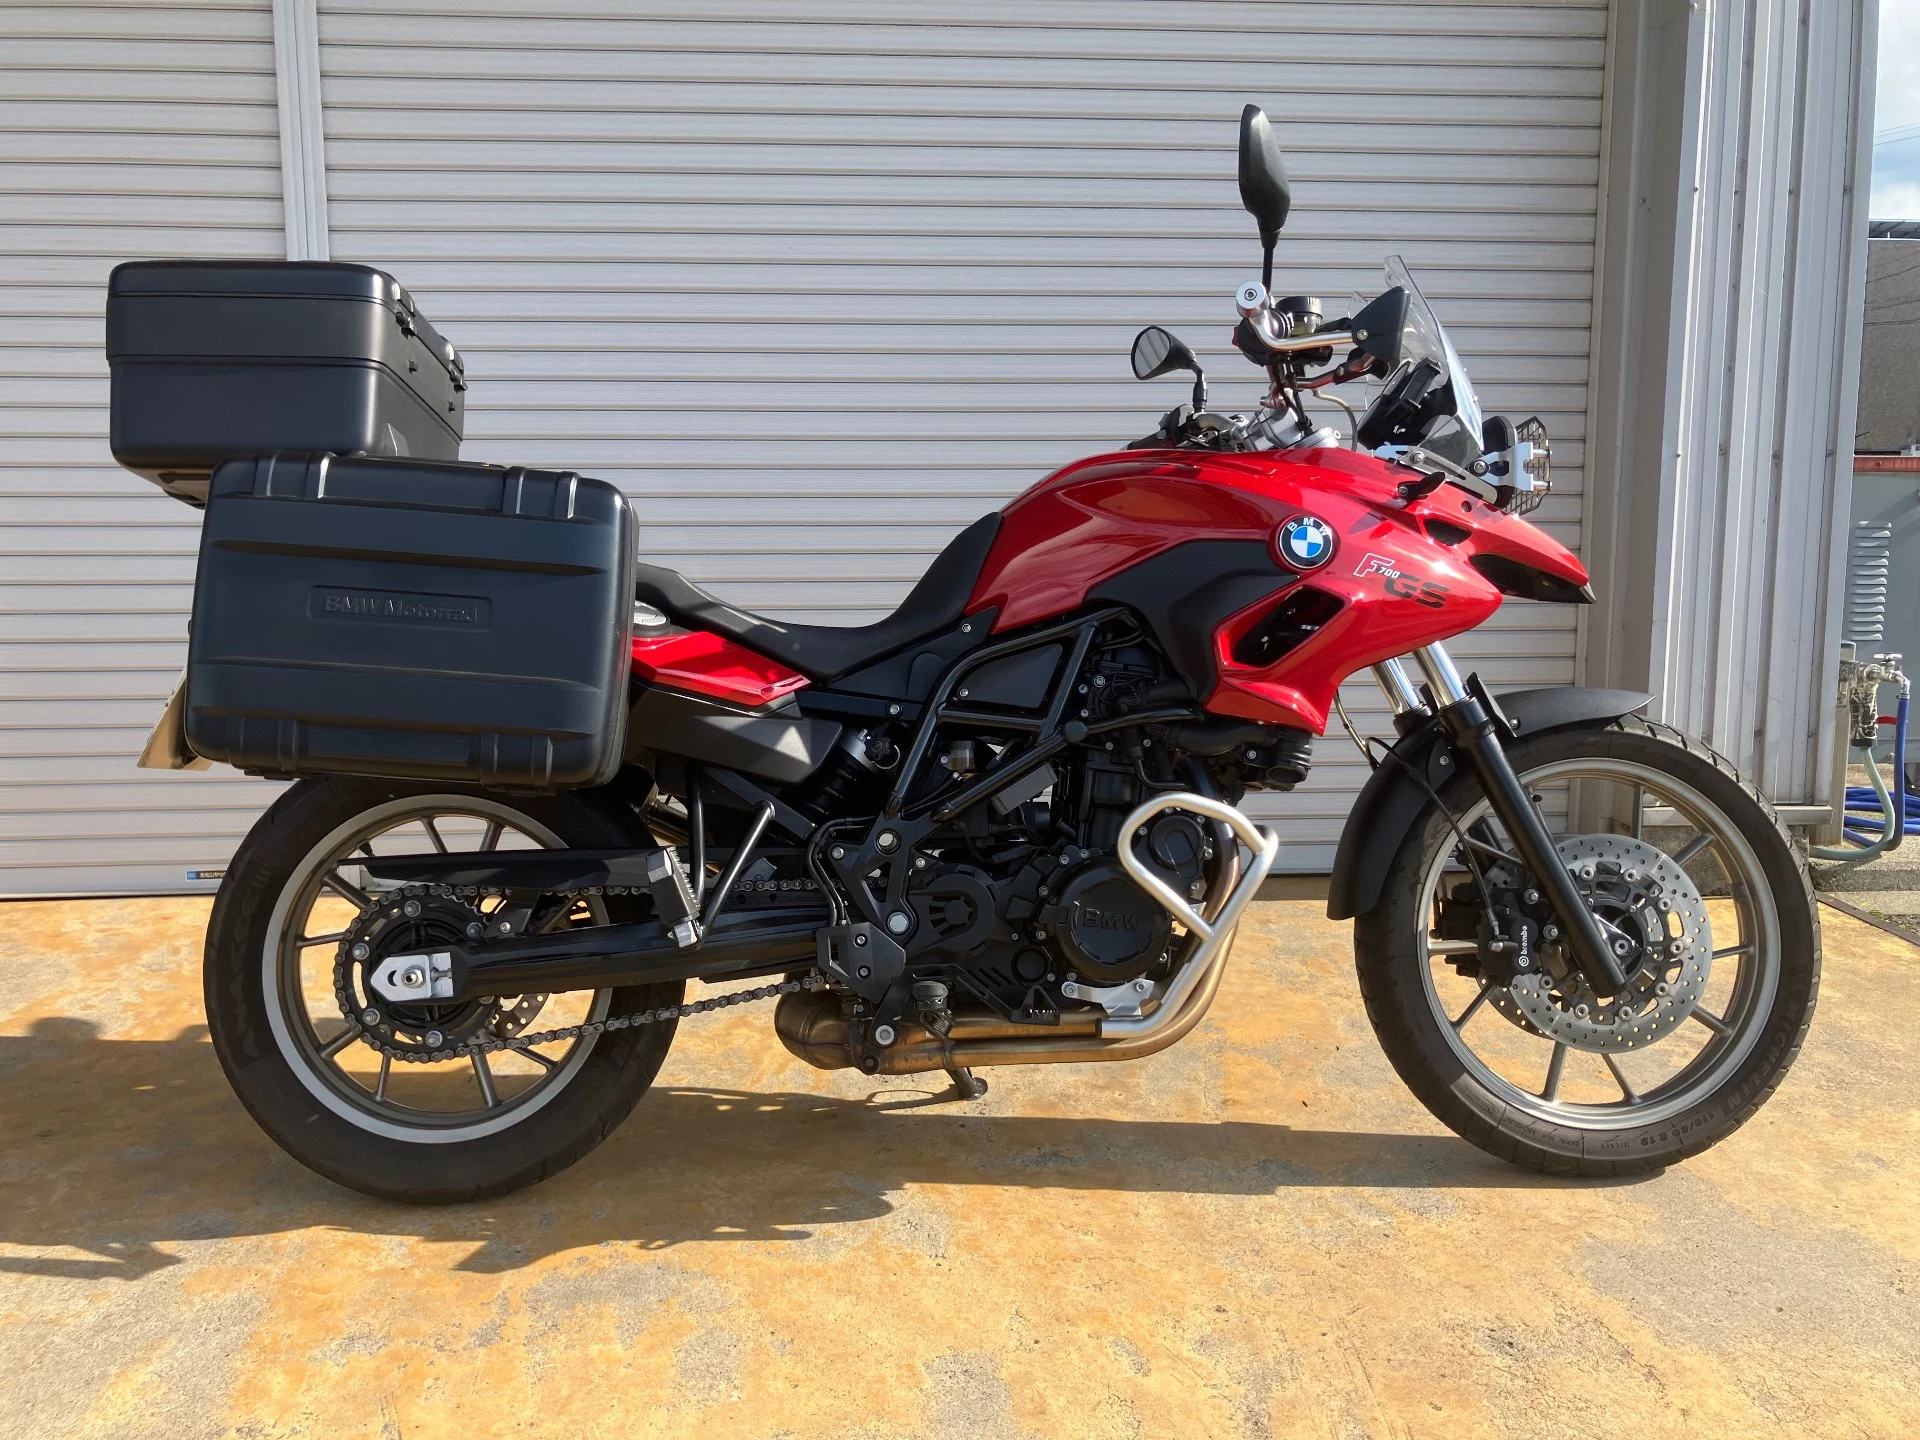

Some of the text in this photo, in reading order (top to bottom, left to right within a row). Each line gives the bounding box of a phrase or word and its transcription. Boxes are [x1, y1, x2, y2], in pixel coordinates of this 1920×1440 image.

[1286, 516, 1329, 537] BMW
[1352, 552, 1451, 609] F 700 GS
[324, 595, 479, 623] BMW Motorrad
[1083, 908, 1143, 934] BMW
[1520, 925, 1528, 955] brembo
[1727, 1000, 1802, 1111] MICHELIN
